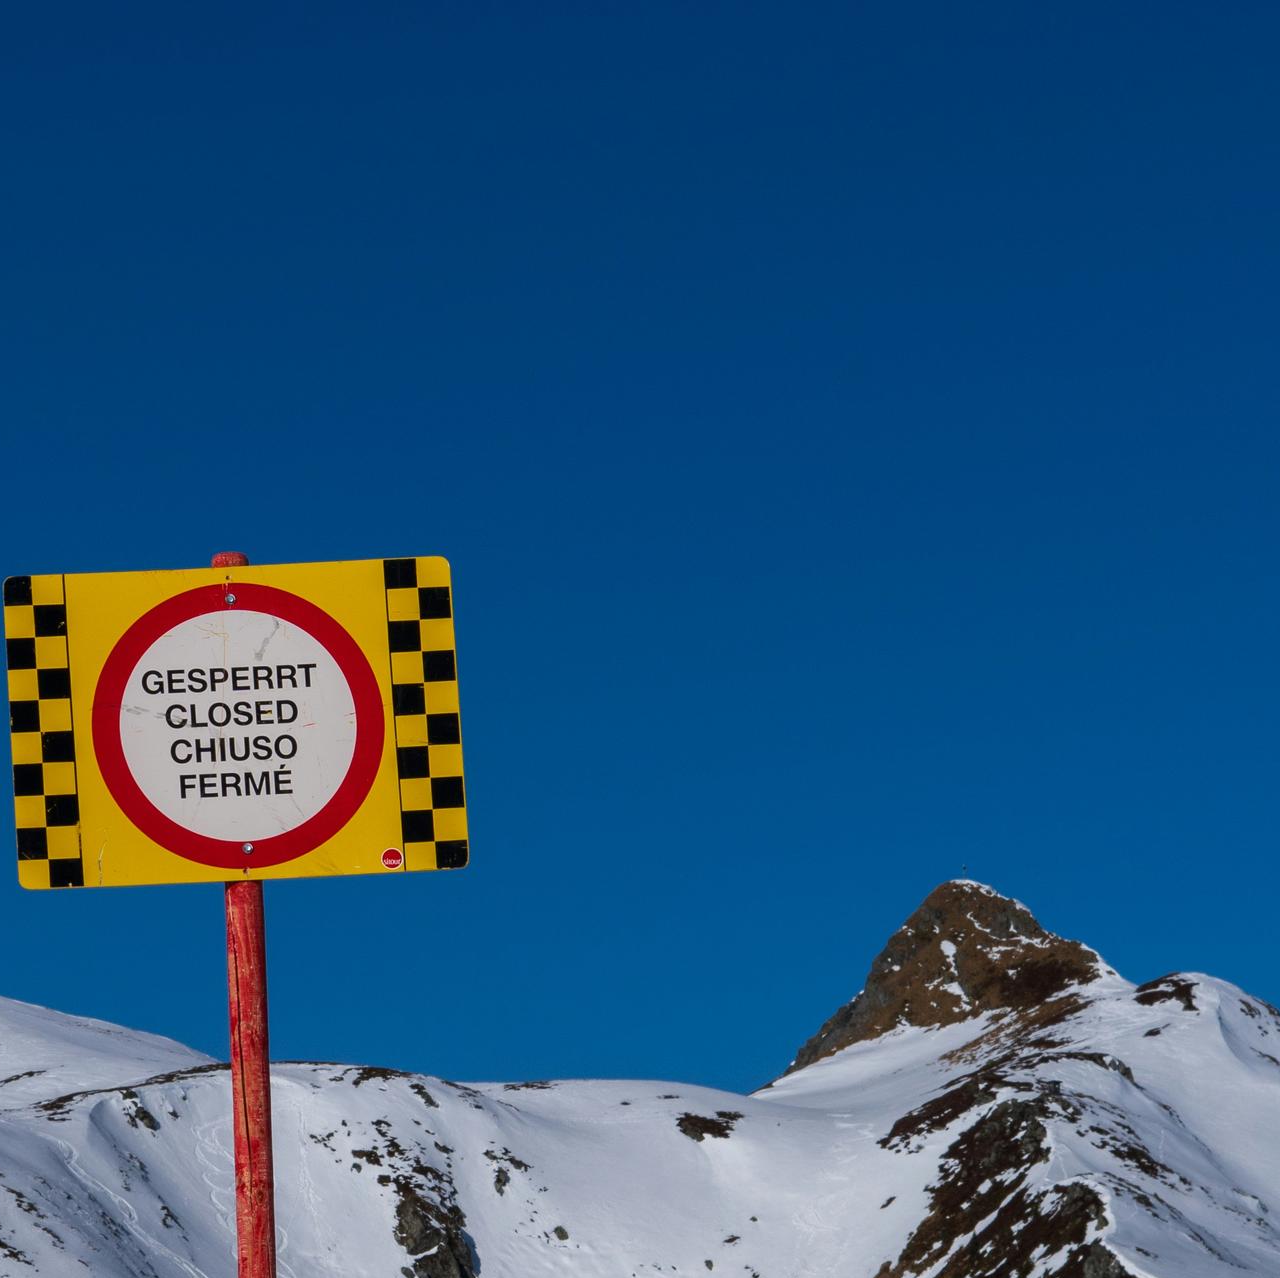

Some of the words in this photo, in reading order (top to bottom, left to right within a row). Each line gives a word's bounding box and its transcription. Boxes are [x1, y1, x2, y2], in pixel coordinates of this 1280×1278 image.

[141, 663, 317, 695] GESPERRT
[165, 700, 298, 729] CLOSED
[170, 734, 298, 764] CHIUSO
[179, 763, 294, 799] FERMÉ
